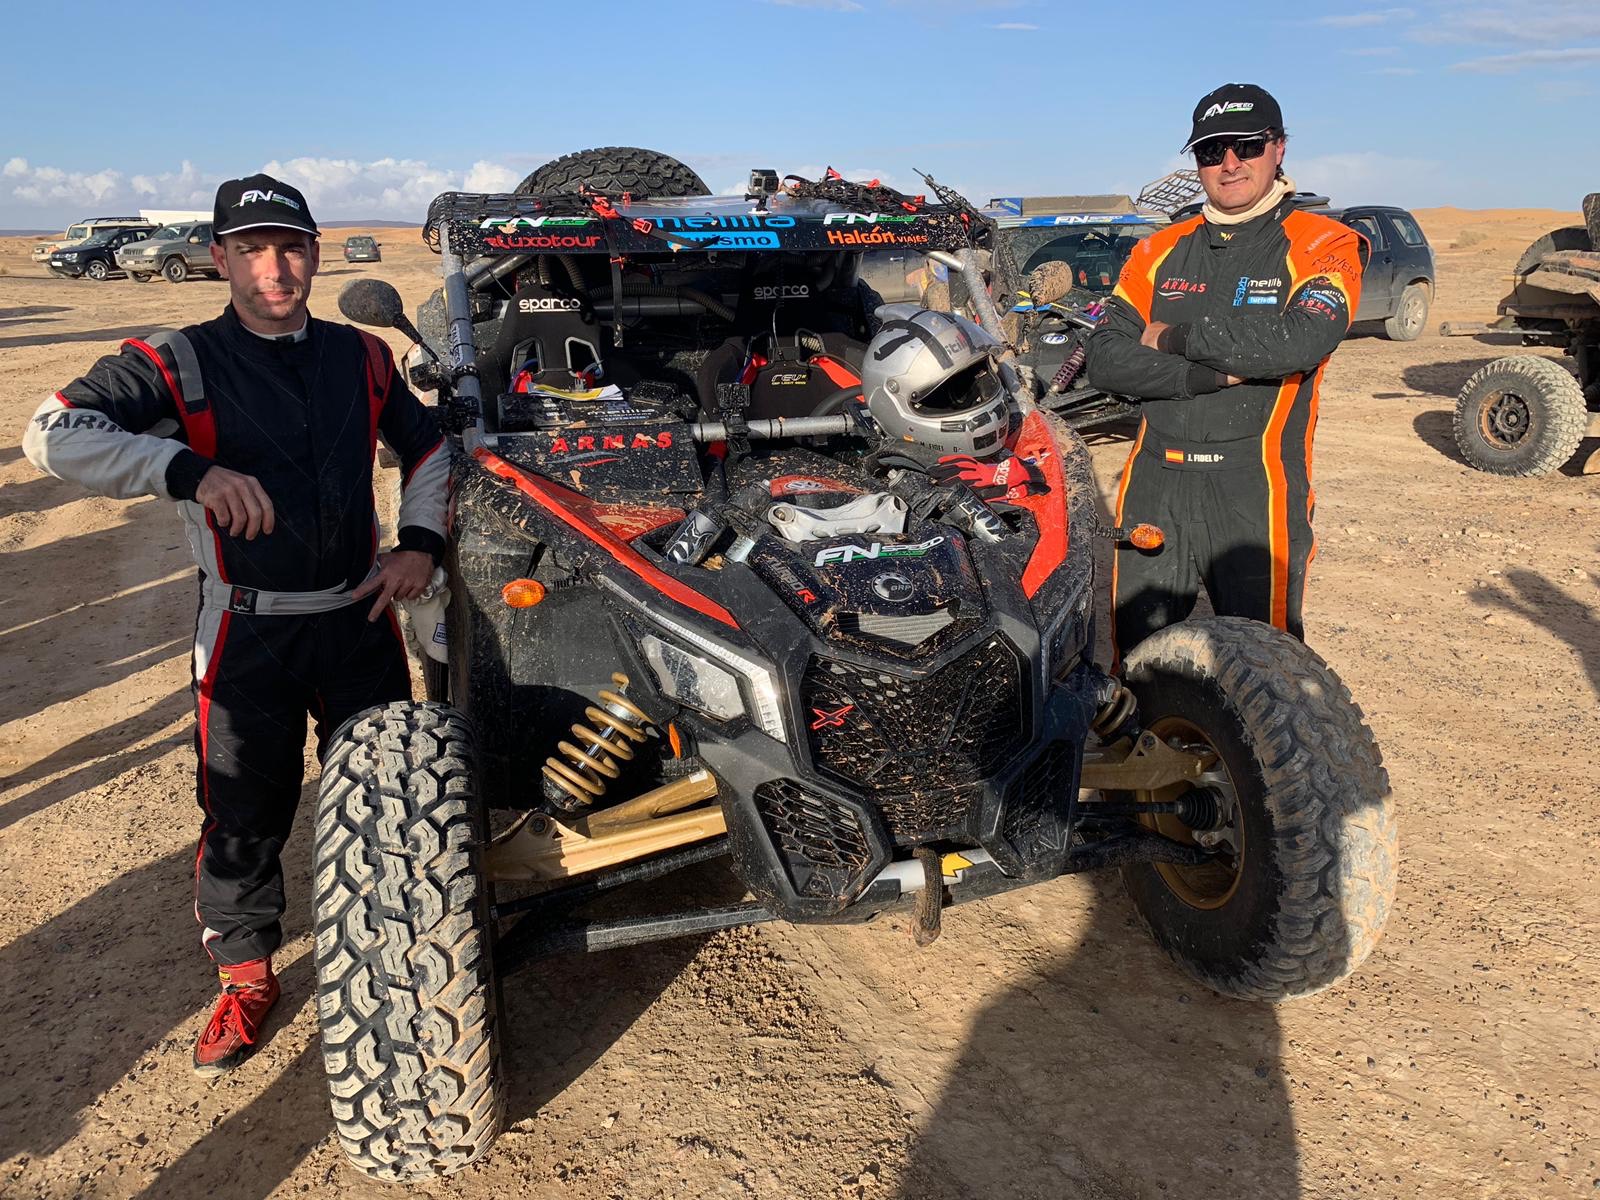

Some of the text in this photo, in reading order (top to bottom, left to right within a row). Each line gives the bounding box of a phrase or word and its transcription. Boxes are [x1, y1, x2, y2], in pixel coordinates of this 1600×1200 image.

[827, 226, 929, 245] Halcón VIAJES
[1161, 280, 1207, 293] ARMAS
[519, 298, 581, 312] sparco
[550, 431, 673, 453] ARMAS
[1193, 454, 1213, 462] FIDEL
[814, 536, 945, 567] FN SPEED
